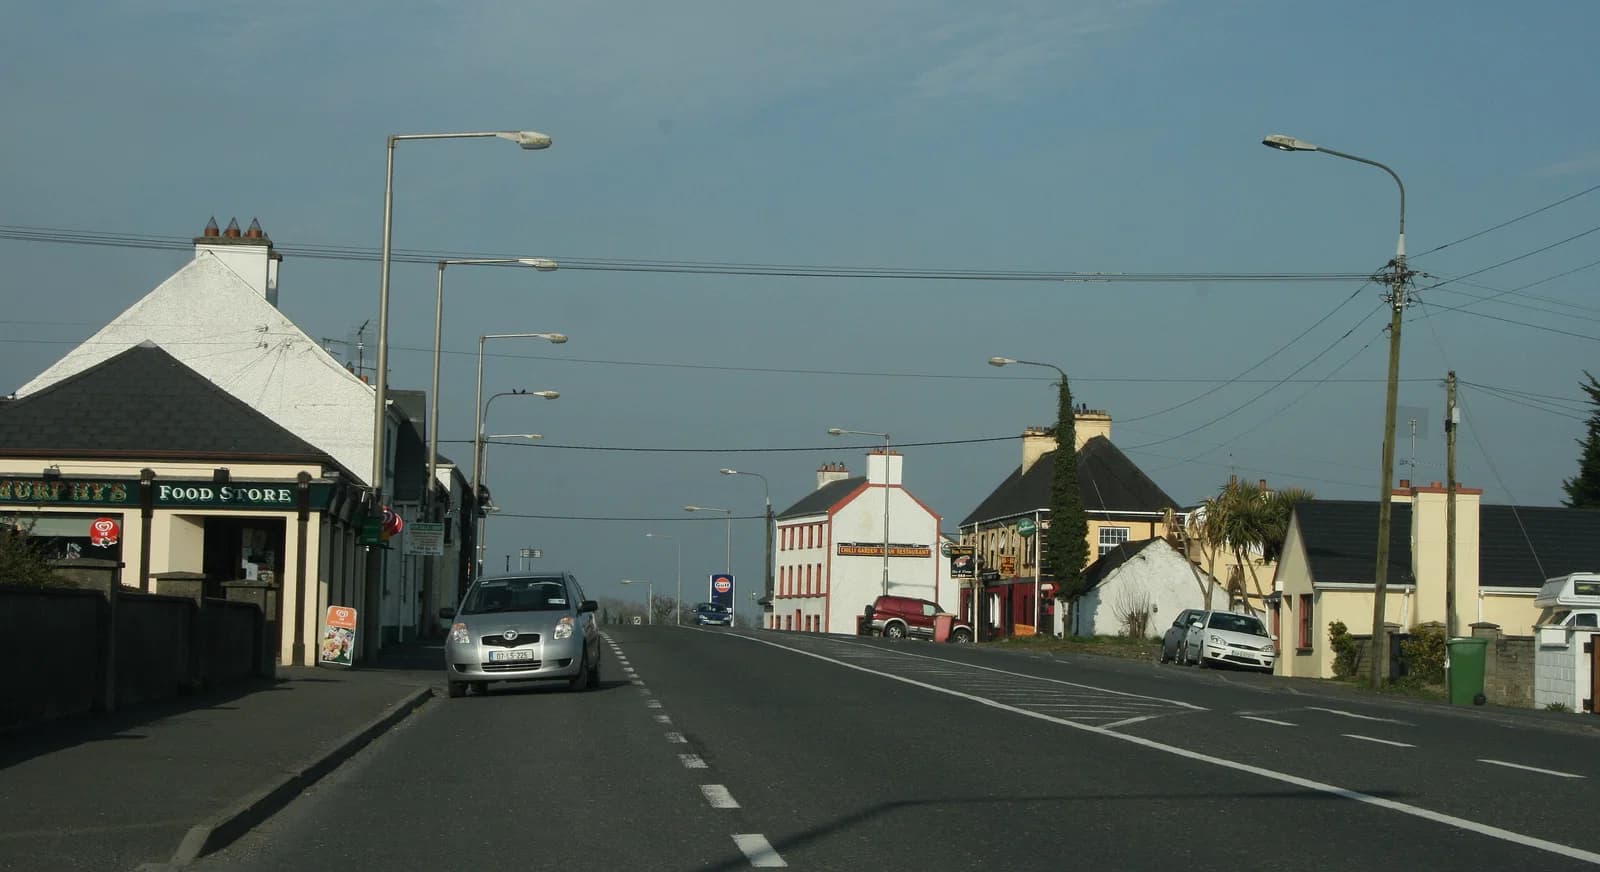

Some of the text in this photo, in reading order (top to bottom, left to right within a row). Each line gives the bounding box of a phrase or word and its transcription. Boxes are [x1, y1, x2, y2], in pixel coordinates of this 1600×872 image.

[159, 485, 292, 502] FOOD STORE
[896, 548, 929, 556] RESTAURANT
